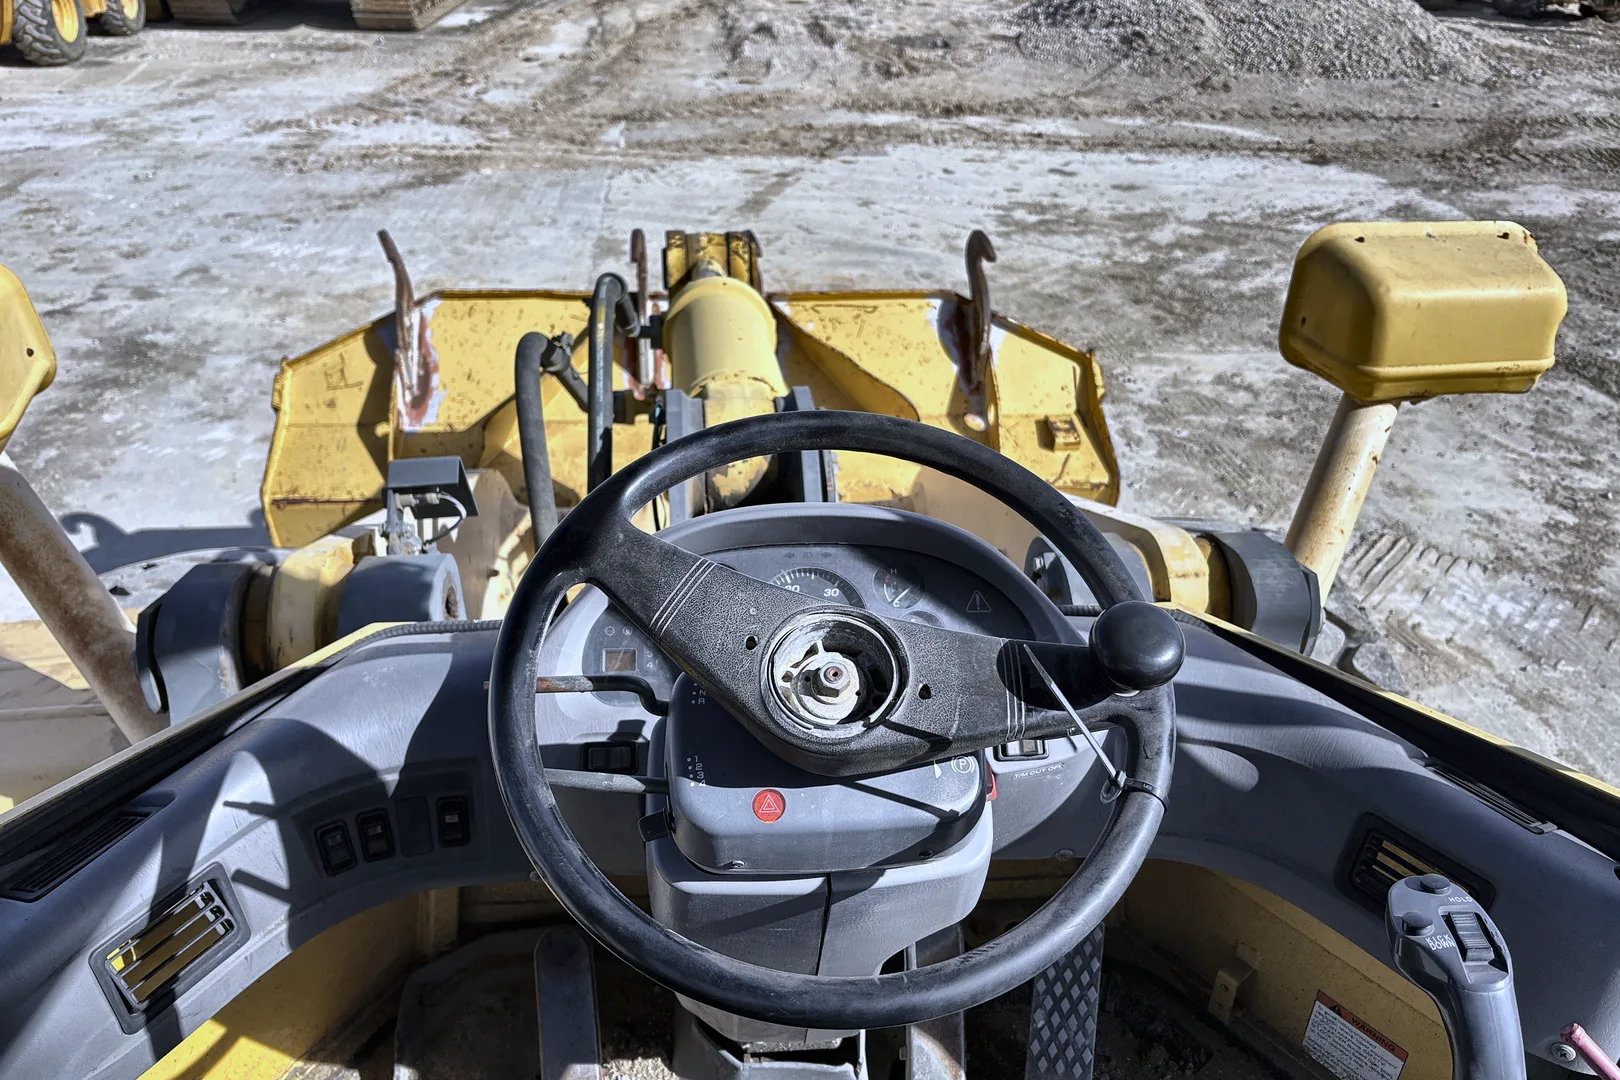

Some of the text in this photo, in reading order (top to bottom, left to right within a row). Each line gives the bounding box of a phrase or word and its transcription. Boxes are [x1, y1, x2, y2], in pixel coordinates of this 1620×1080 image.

[823, 588, 840, 597] 30
[696, 771, 704, 779] 3
[1029, 768, 1045, 776] CUT
[1425, 934, 1452, 943] KICK
[1429, 940, 1456, 951] DOWN
[1351, 1016, 1397, 1052] WARNING
